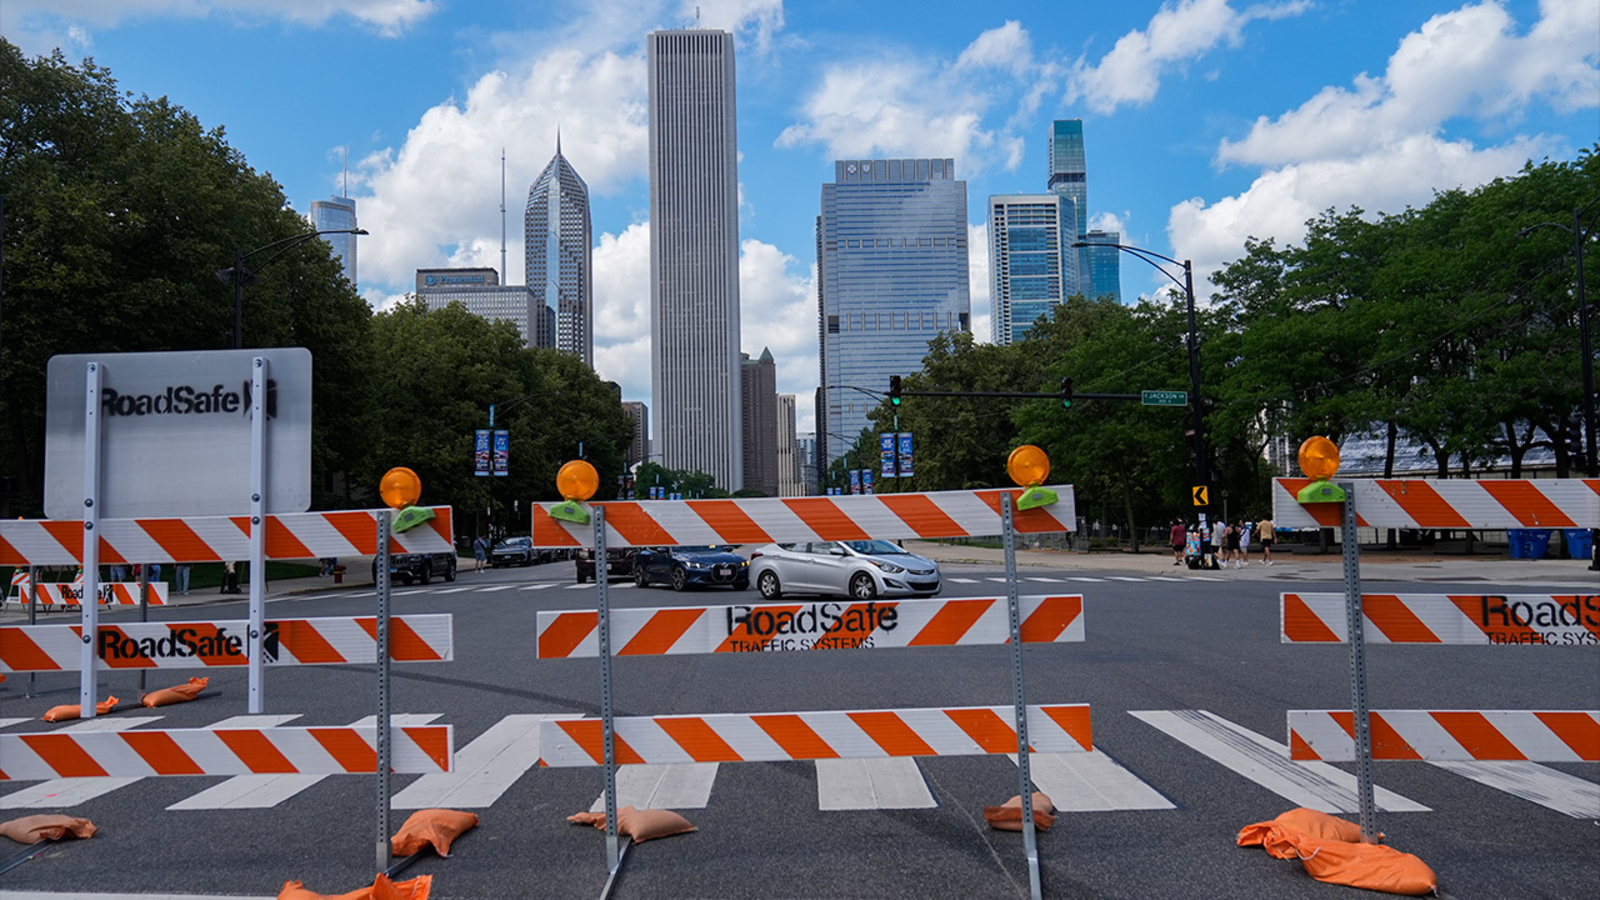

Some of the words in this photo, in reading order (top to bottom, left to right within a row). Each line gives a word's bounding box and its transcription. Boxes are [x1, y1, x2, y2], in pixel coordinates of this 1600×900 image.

[440, 274, 484, 283] Prudential
[102, 384, 240, 416] RoadSafe
[62, 585, 102, 599] Roade
[727, 602, 898, 636] RoadSafe
[99, 627, 243, 659] RoadSafe
[730, 638, 796, 652] TRAFFIC
[800, 636, 875, 650] SYSTEMS
[1487, 632, 1557, 645] TRAFFIC
[1563, 632, 1600, 645] SYS
